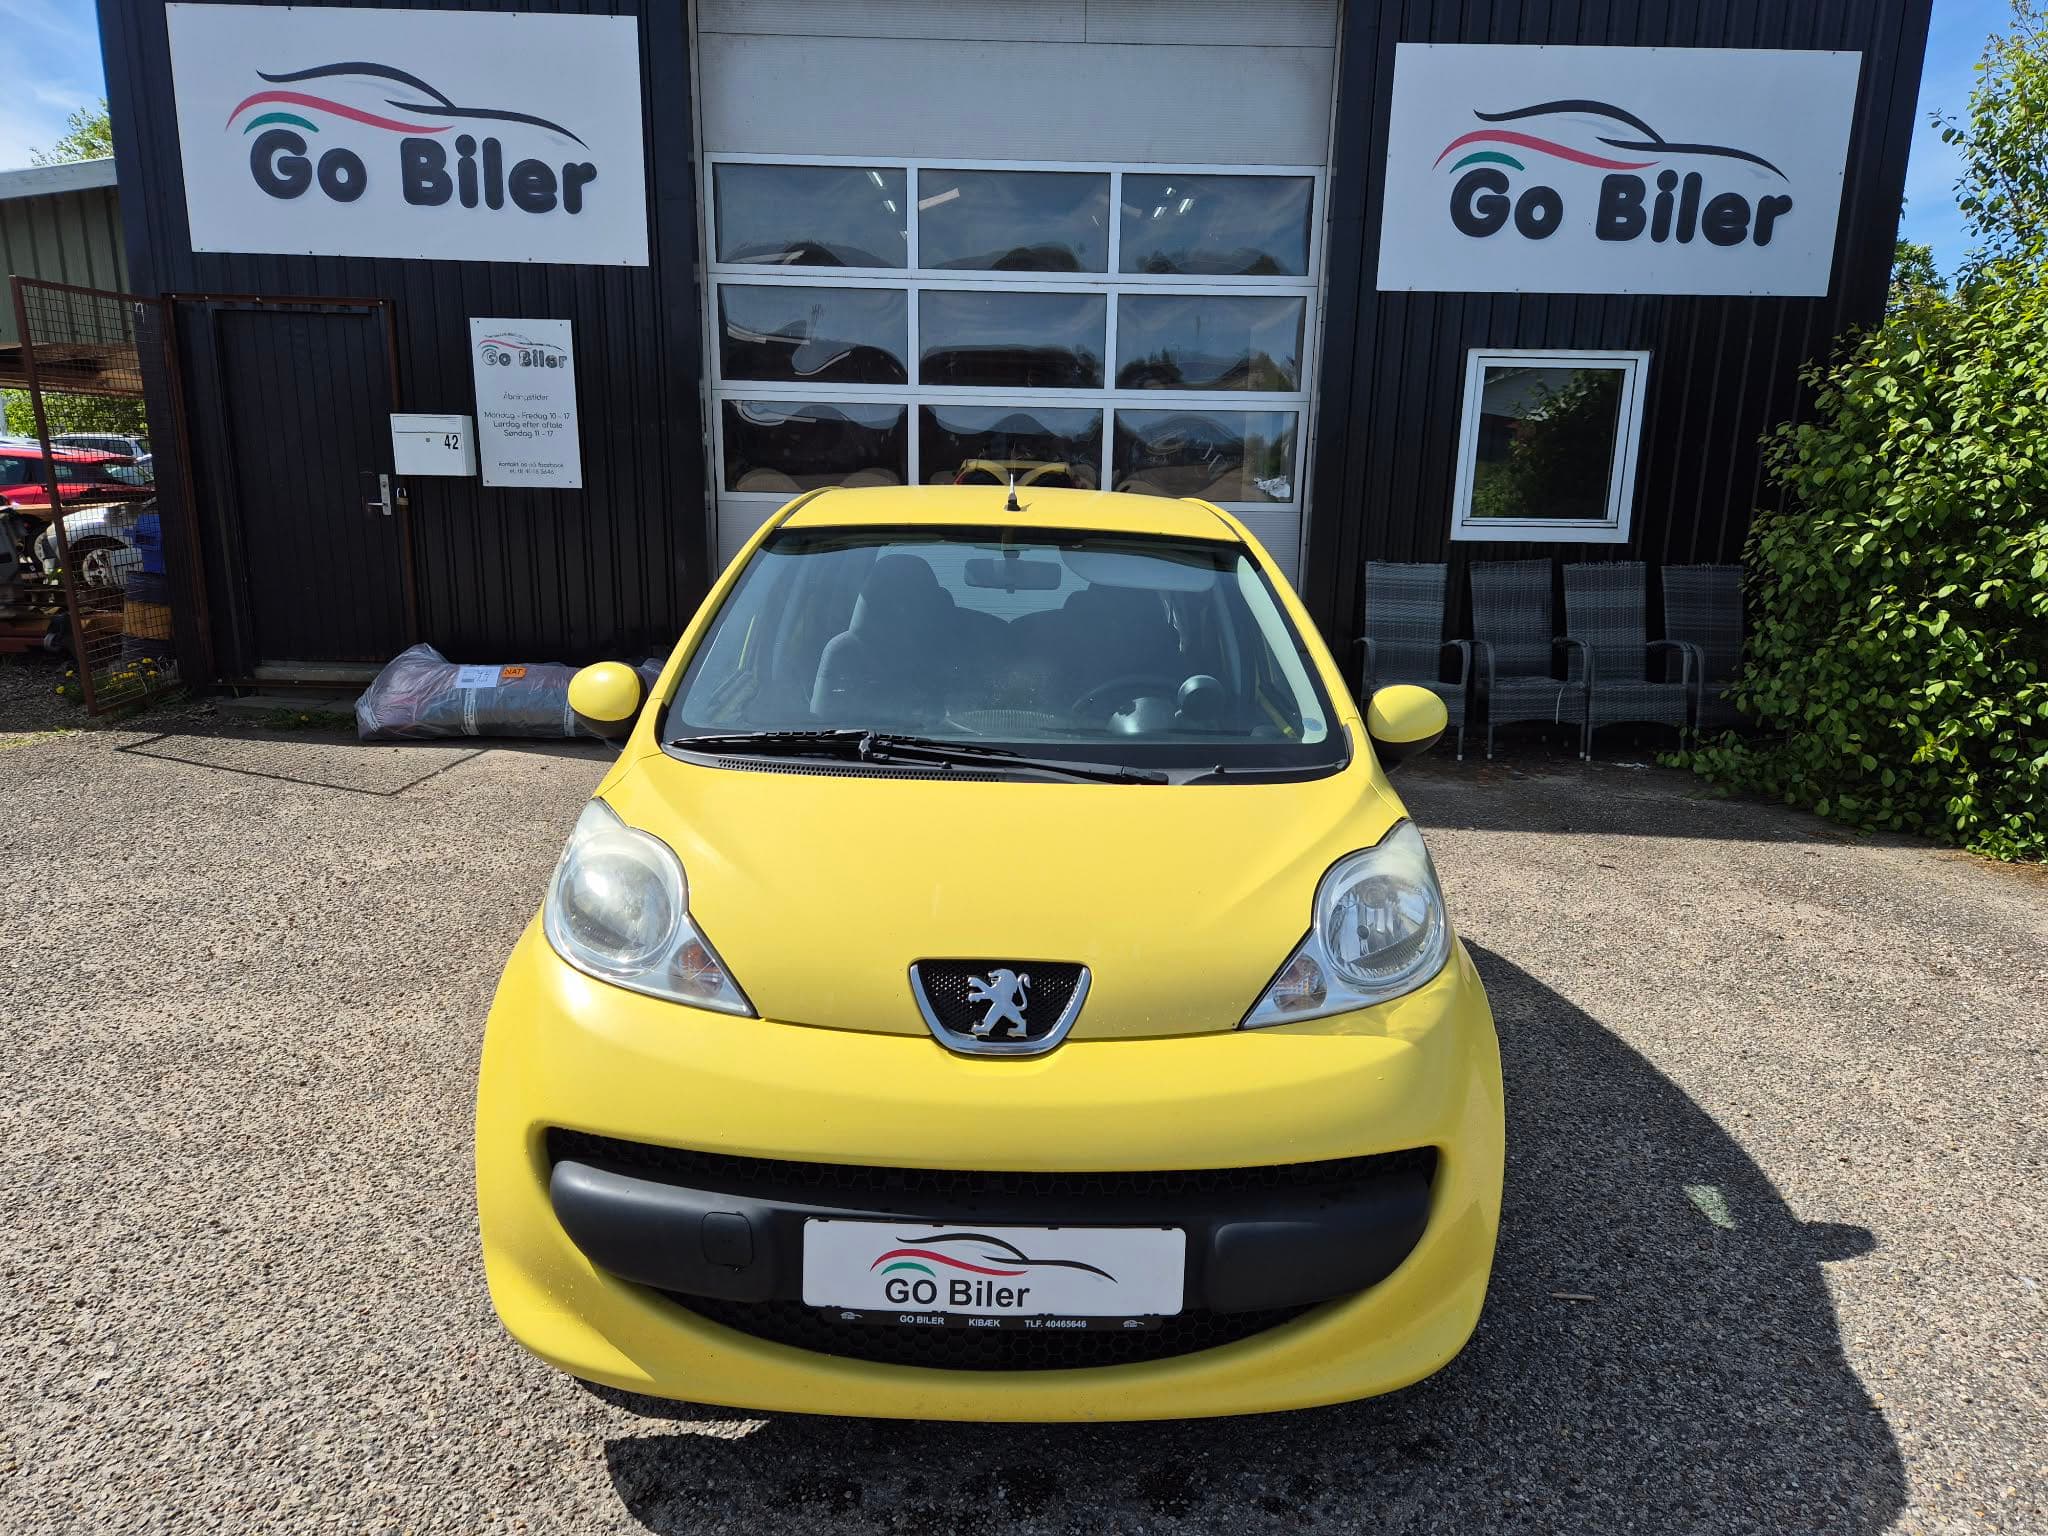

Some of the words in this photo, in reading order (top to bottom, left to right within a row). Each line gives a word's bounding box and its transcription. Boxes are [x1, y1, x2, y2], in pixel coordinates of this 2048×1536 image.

[250, 128, 367, 202] Go
[400, 134, 598, 214] Biler
[1450, 168, 1564, 240] Go
[1595, 169, 1793, 247] Biler
[482, 349, 512, 366] Go
[519, 349, 567, 369] Biler
[521, 411, 548, 420] Fredag
[522, 421, 540, 429] efter
[503, 429, 533, 438] Søndag
[444, 434, 459, 450] 42
[885, 1278, 937, 1304] GO
[949, 1279, 1030, 1308] Biler
[900, 1314, 914, 1324] GO
[916, 1315, 945, 1325] BILER
[968, 1317, 1000, 1327] KIBÆK
[1024, 1319, 1043, 1328] TLF.
[1045, 1319, 1087, 1328] 40465646
